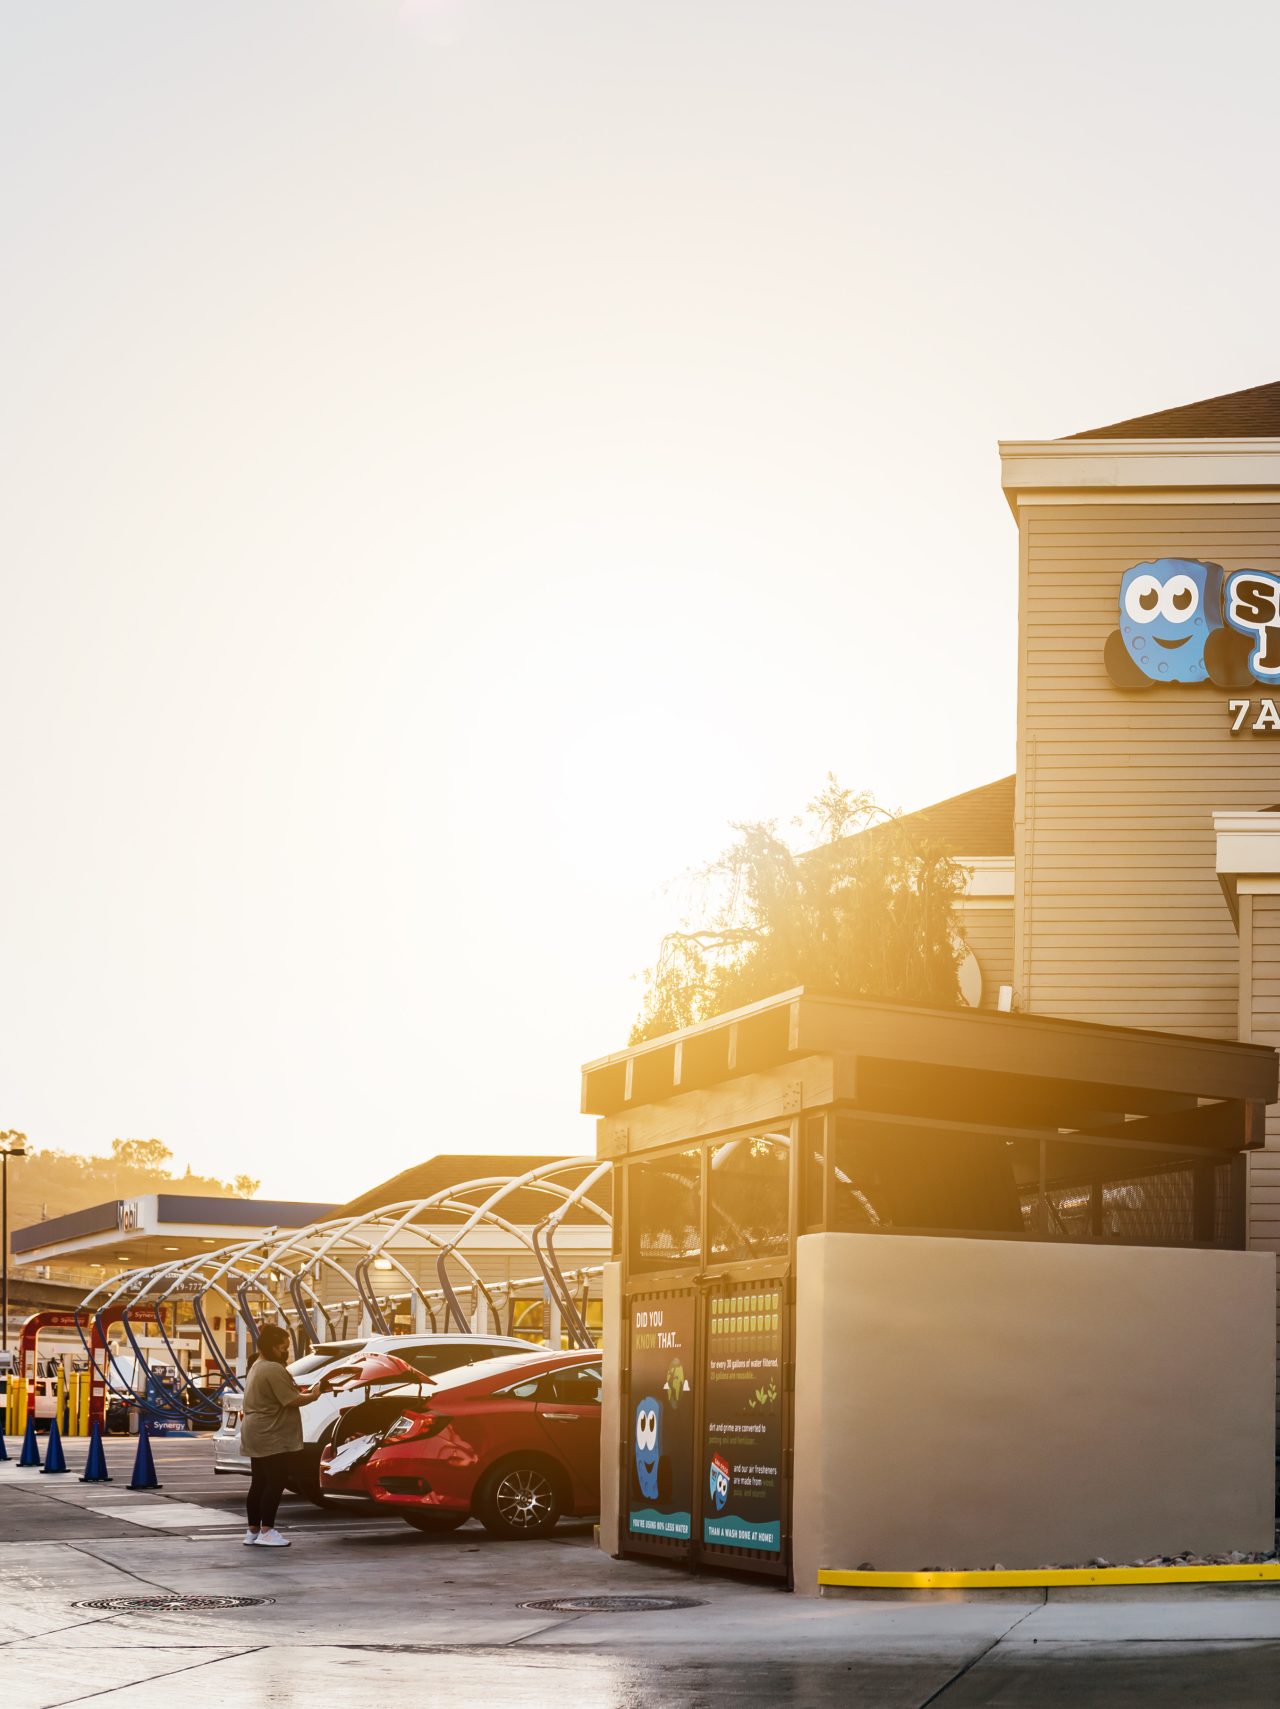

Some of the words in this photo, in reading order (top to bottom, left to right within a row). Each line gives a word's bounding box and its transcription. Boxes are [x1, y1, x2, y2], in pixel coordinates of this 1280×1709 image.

[116, 1200, 139, 1231] Mobil
[636, 1312, 648, 1328] DID
[649, 1311, 664, 1327] YOU
[636, 1333, 656, 1350] KNOW
[716, 1361, 727, 1370] every
[732, 1360, 746, 1370] gallons
[751, 1359, 762, 1368] water
[153, 1421, 186, 1431] Synergy
[741, 1424, 761, 1433] converted
[761, 1424, 767, 1433] to
[733, 1464, 741, 1473] and
[755, 1464, 778, 1475] fresheners
[733, 1477, 741, 1485] are
[741, 1476, 752, 1486] made
[752, 1476, 762, 1486] from
[645, 1520, 657, 1529] USING
[665, 1522, 675, 1532] LESS
[675, 1523, 689, 1534] WATER
[708, 1526, 720, 1536] THAN
[721, 1527, 725, 1536] A
[725, 1528, 738, 1538] WASH
[738, 1529, 751, 1540] DONE
[751, 1531, 758, 1540] AT
[758, 1532, 774, 1543] HOME!
